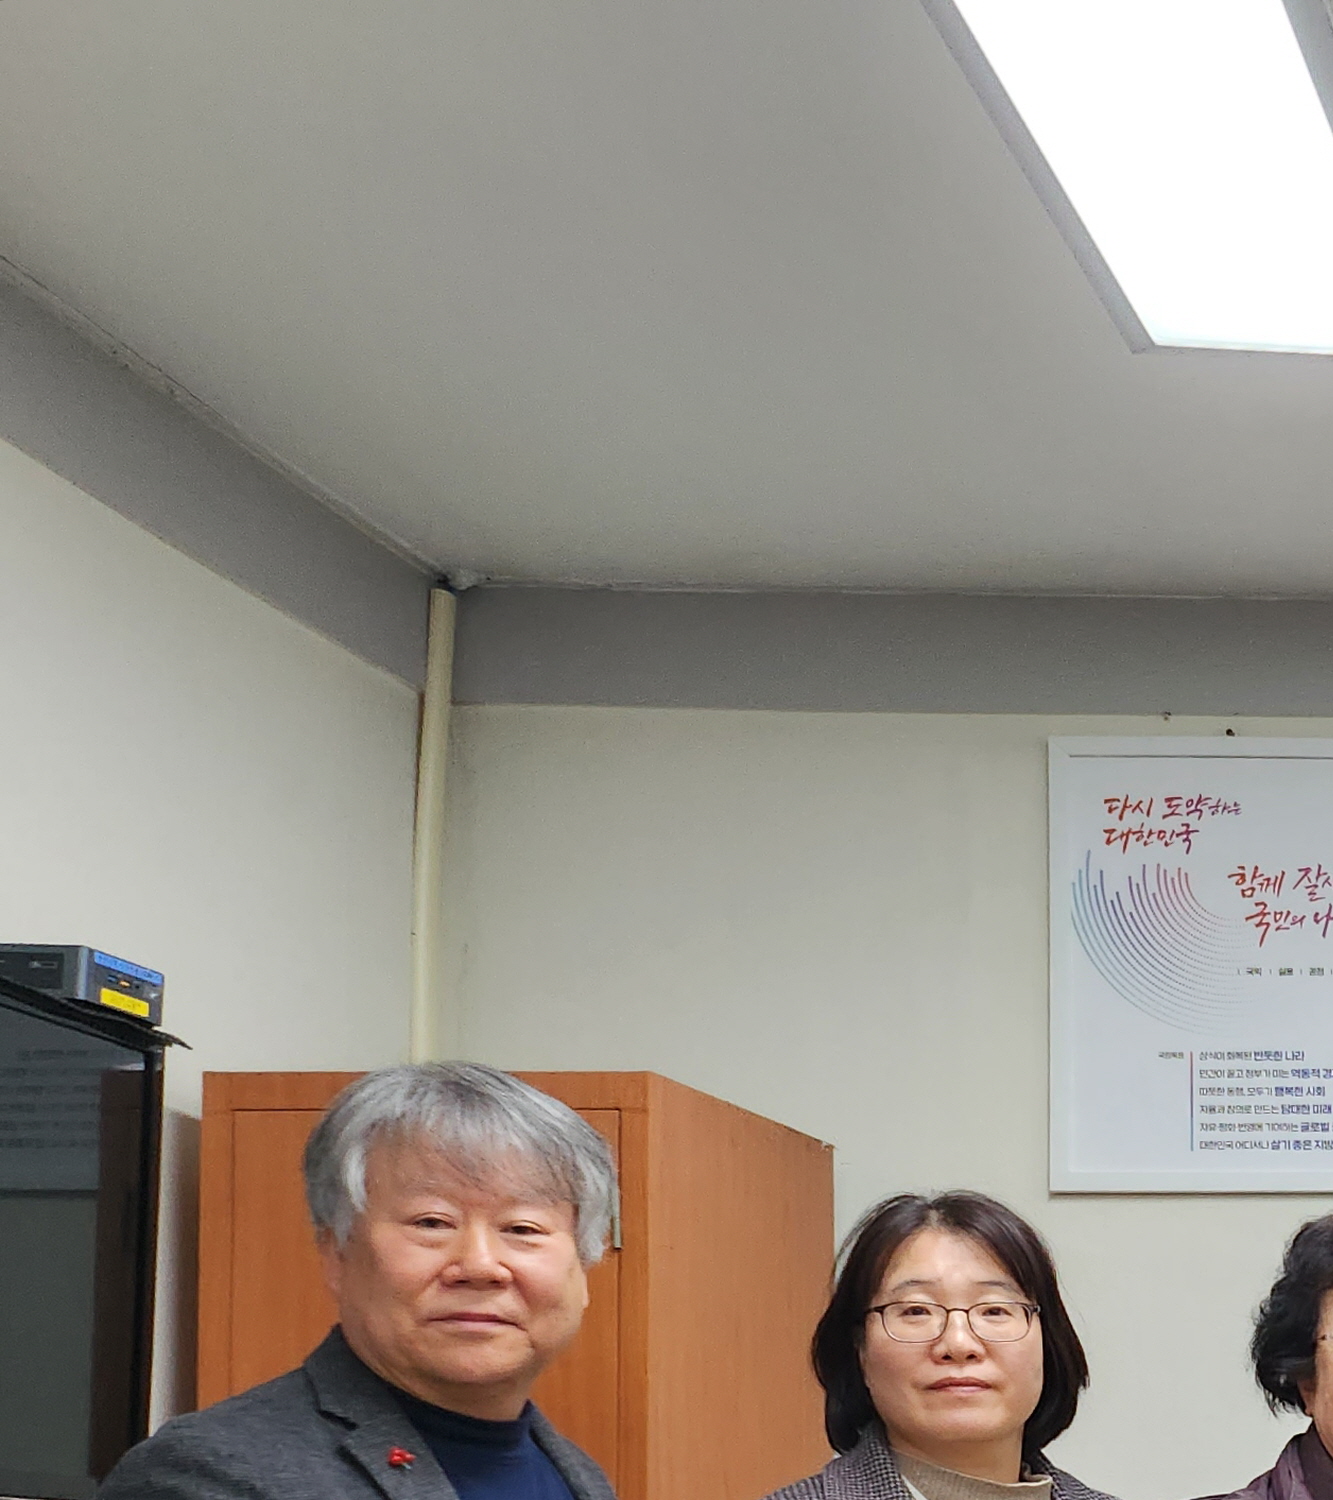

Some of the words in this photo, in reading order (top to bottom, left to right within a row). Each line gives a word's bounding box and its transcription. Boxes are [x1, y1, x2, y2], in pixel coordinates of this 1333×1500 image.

[1103, 794, 1154, 821] 다시
[1162, 794, 1243, 821] 도약하는
[1103, 823, 1199, 855] 대한민국
[1227, 865, 1287, 899] 함께
[1245, 901, 1306, 948] 국민의
[1284, 1051, 1305, 1062] 나라
[1305, 1086, 1326, 1097] 사회
[1312, 1103, 1332, 1115] 미래
[1300, 1121, 1330, 1133] 글로벌
